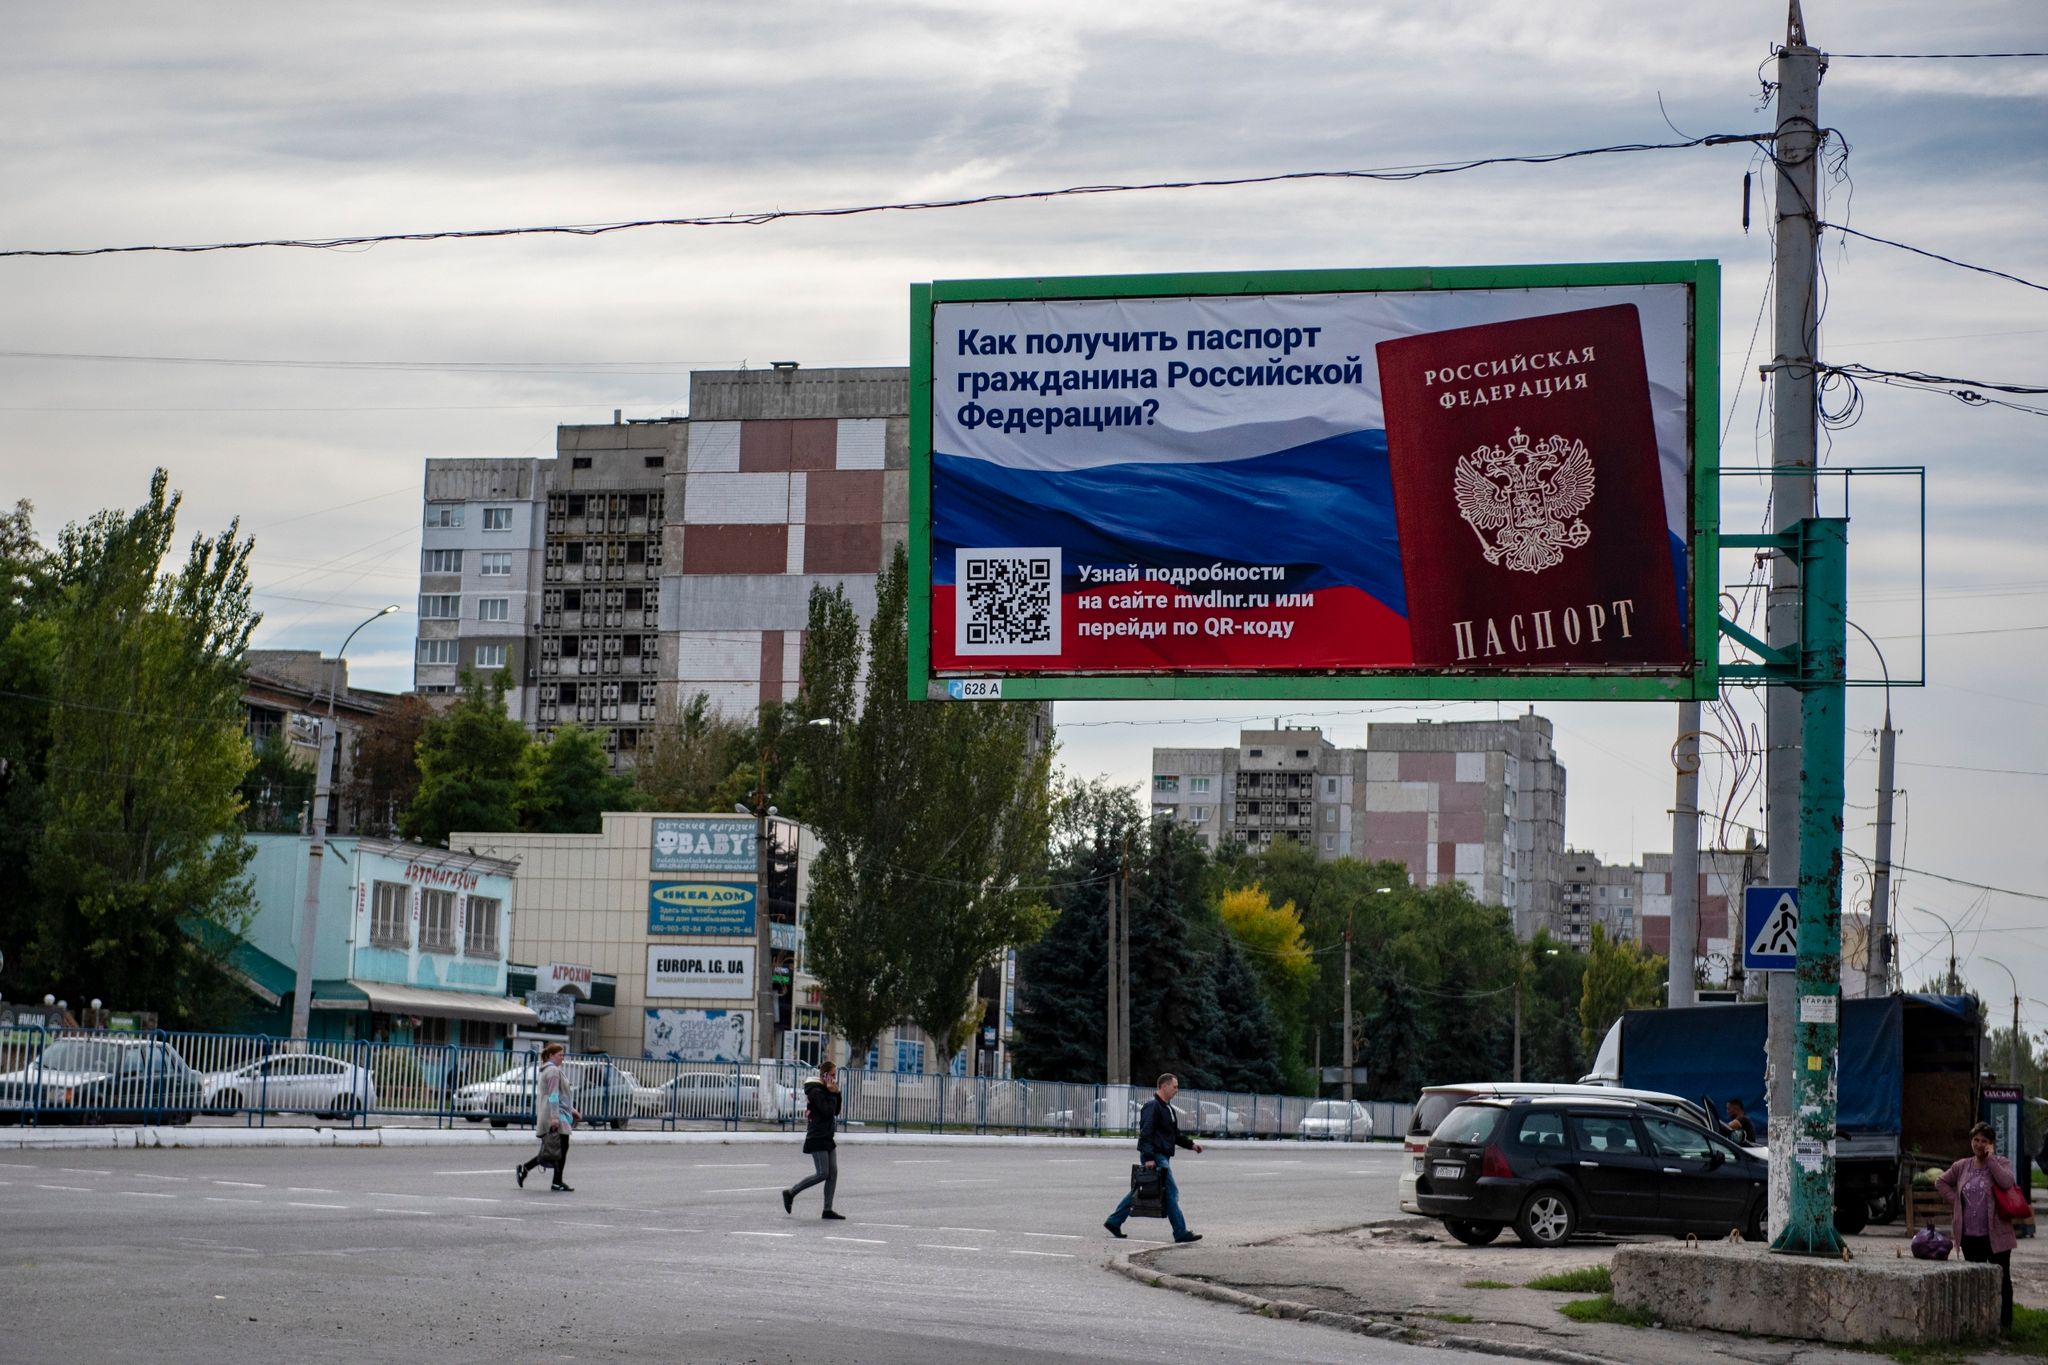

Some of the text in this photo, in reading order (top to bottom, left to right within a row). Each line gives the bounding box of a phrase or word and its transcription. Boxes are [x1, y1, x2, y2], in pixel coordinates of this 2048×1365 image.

[958, 327, 1322, 360] Как получить паспорт
[957, 355, 1363, 399] гражданина Российской
[1424, 346, 1596, 386] РОССИЙСКАЯ
[1439, 373, 1589, 409] ФЕДЕРАЦИЯ
[957, 399, 1160, 434] Федерации?
[1078, 562, 1285, 585] Узнай подробности
[1078, 590, 1314, 609] на сайте mvdlnr.ru или
[1078, 617, 1295, 640] перейди по QR-коду
[1452, 599, 1634, 661] ПАСПОРТ
[964, 683, 986, 695] 628
[677, 833, 748, 855] BABY
[404, 863, 480, 891] АВТОМАГАЗИН
[662, 890, 746, 902] ИКЕА ДОМ
[657, 959, 744, 974] EUROPA. LG. UA
[18, 1013, 46, 1027] #MIAMI
[1471, 1132, 1480, 1142] Z
